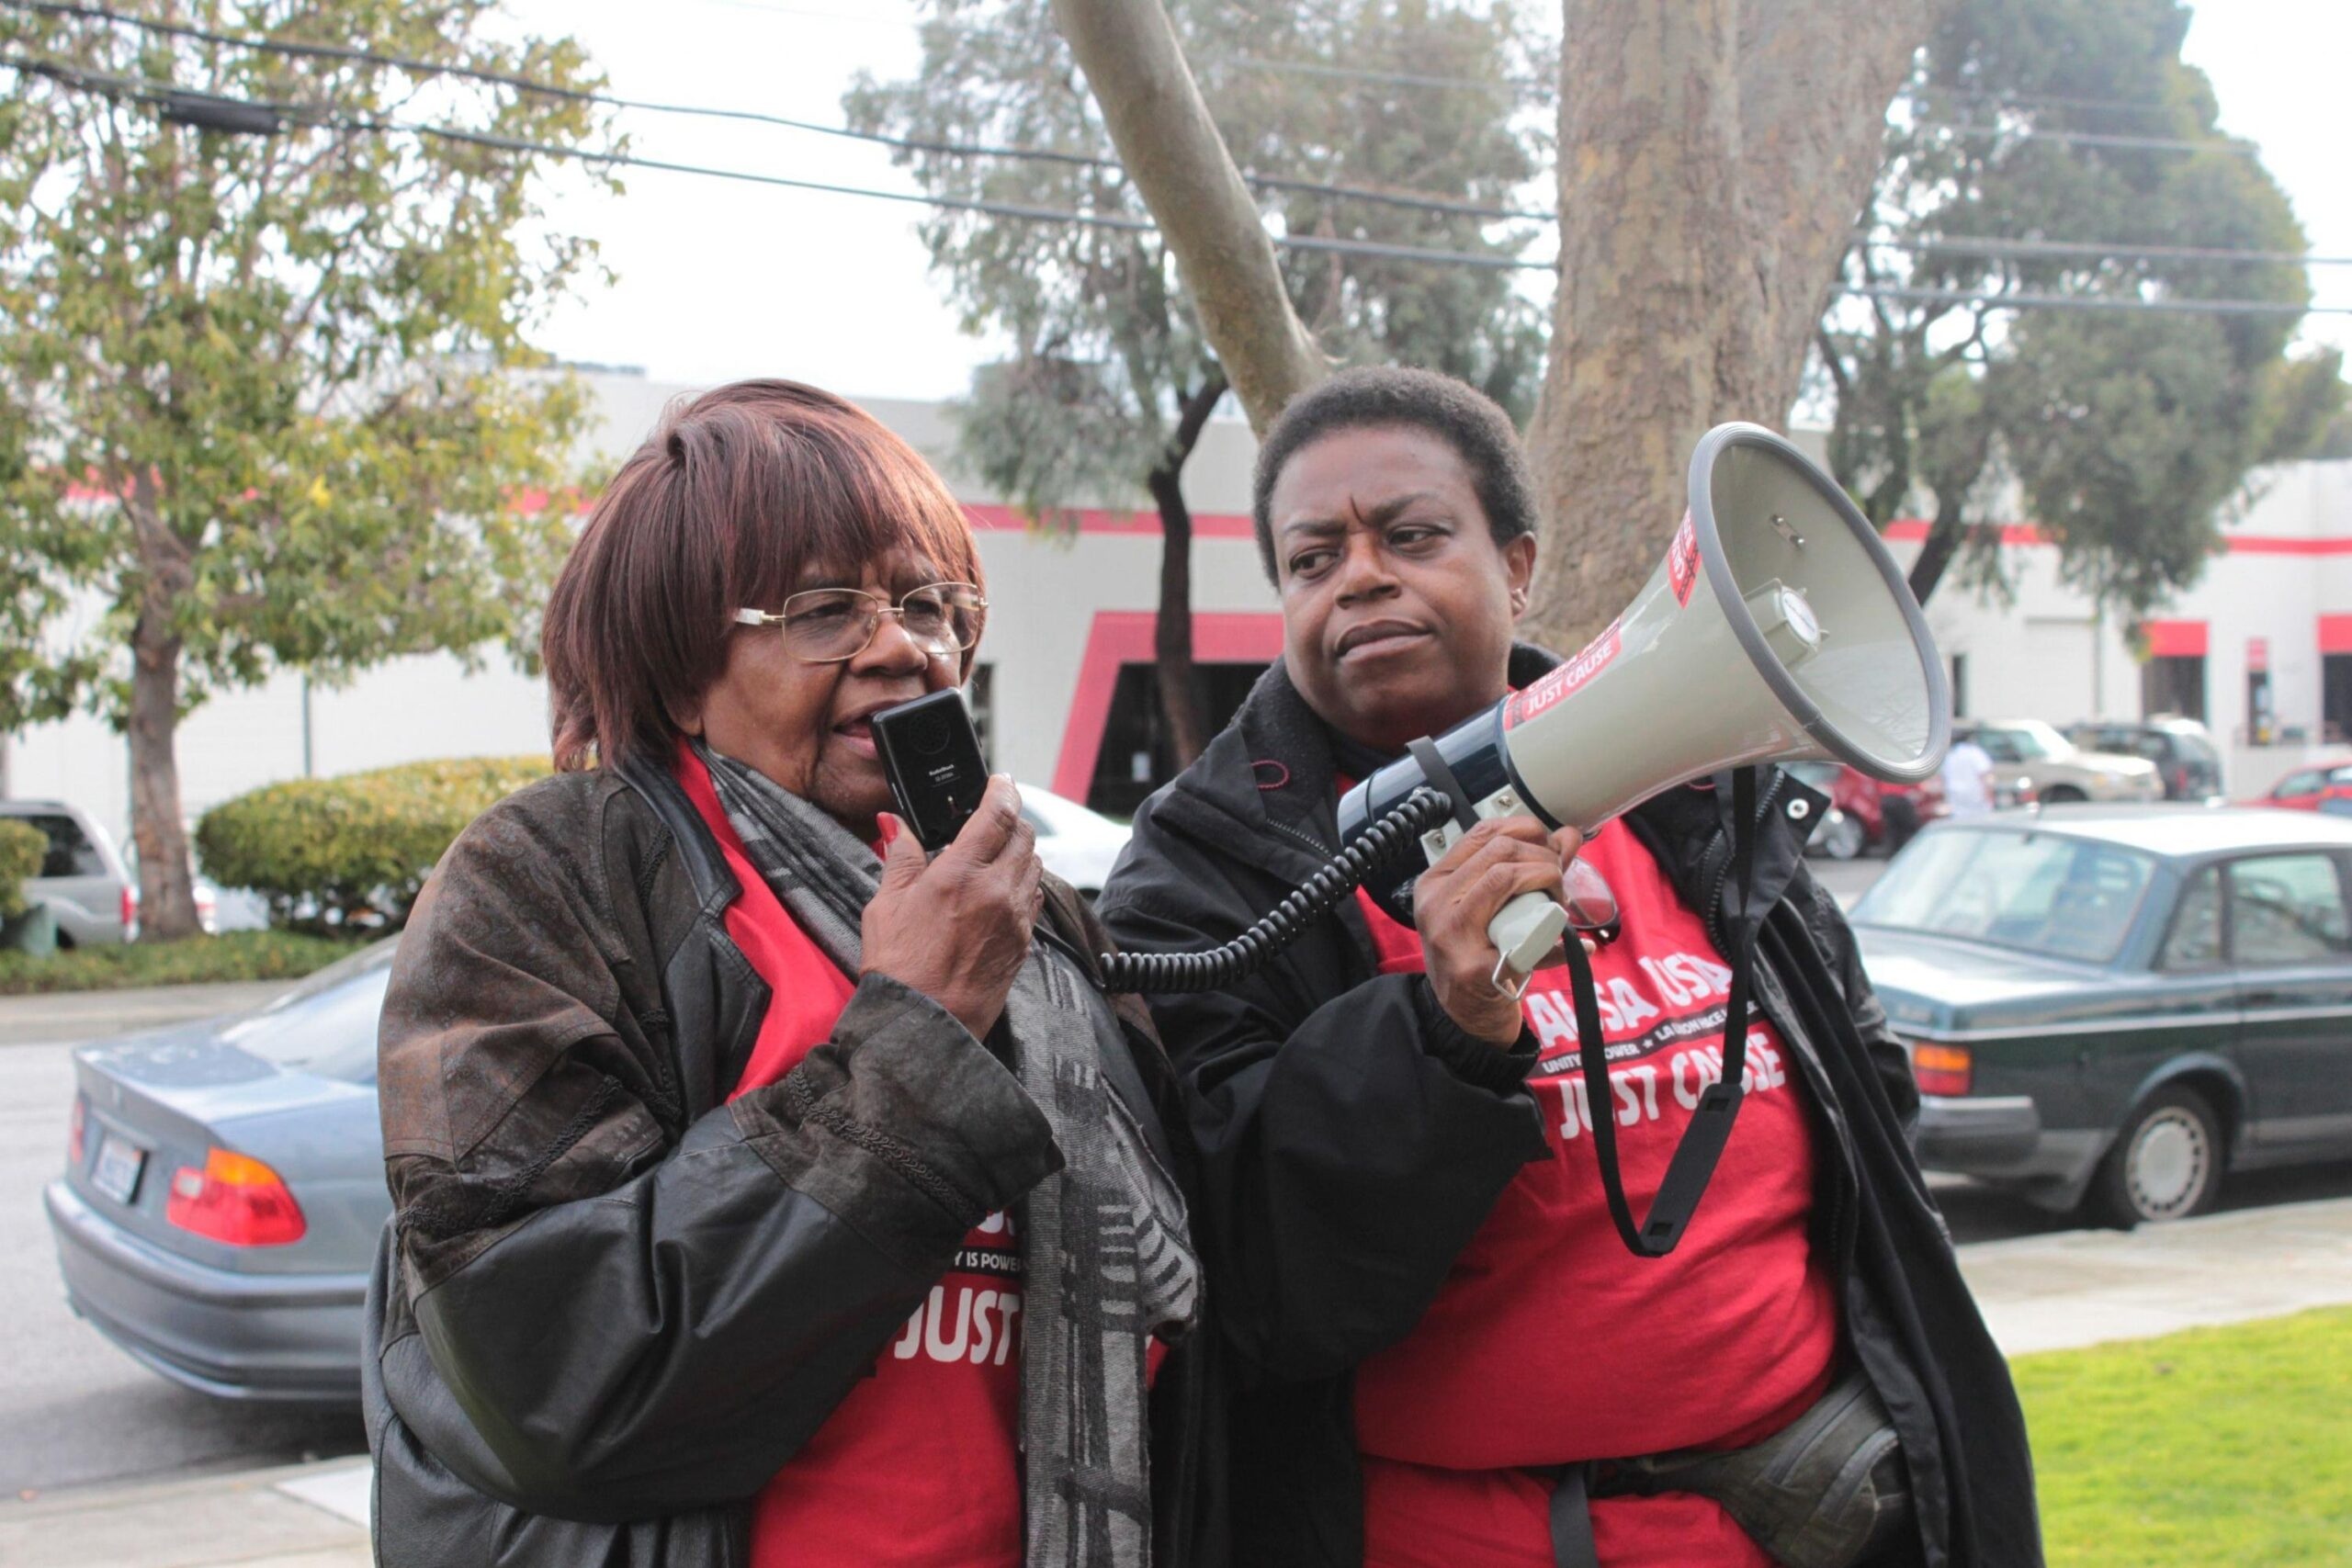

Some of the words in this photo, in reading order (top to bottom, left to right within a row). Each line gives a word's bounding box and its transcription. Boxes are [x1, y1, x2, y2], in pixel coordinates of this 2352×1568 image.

[1526, 682, 1563, 715] JUST
[1565, 642, 1612, 688] CAUSE
[966, 1251, 978, 1268] IS
[894, 1285, 1020, 1366] JUST
